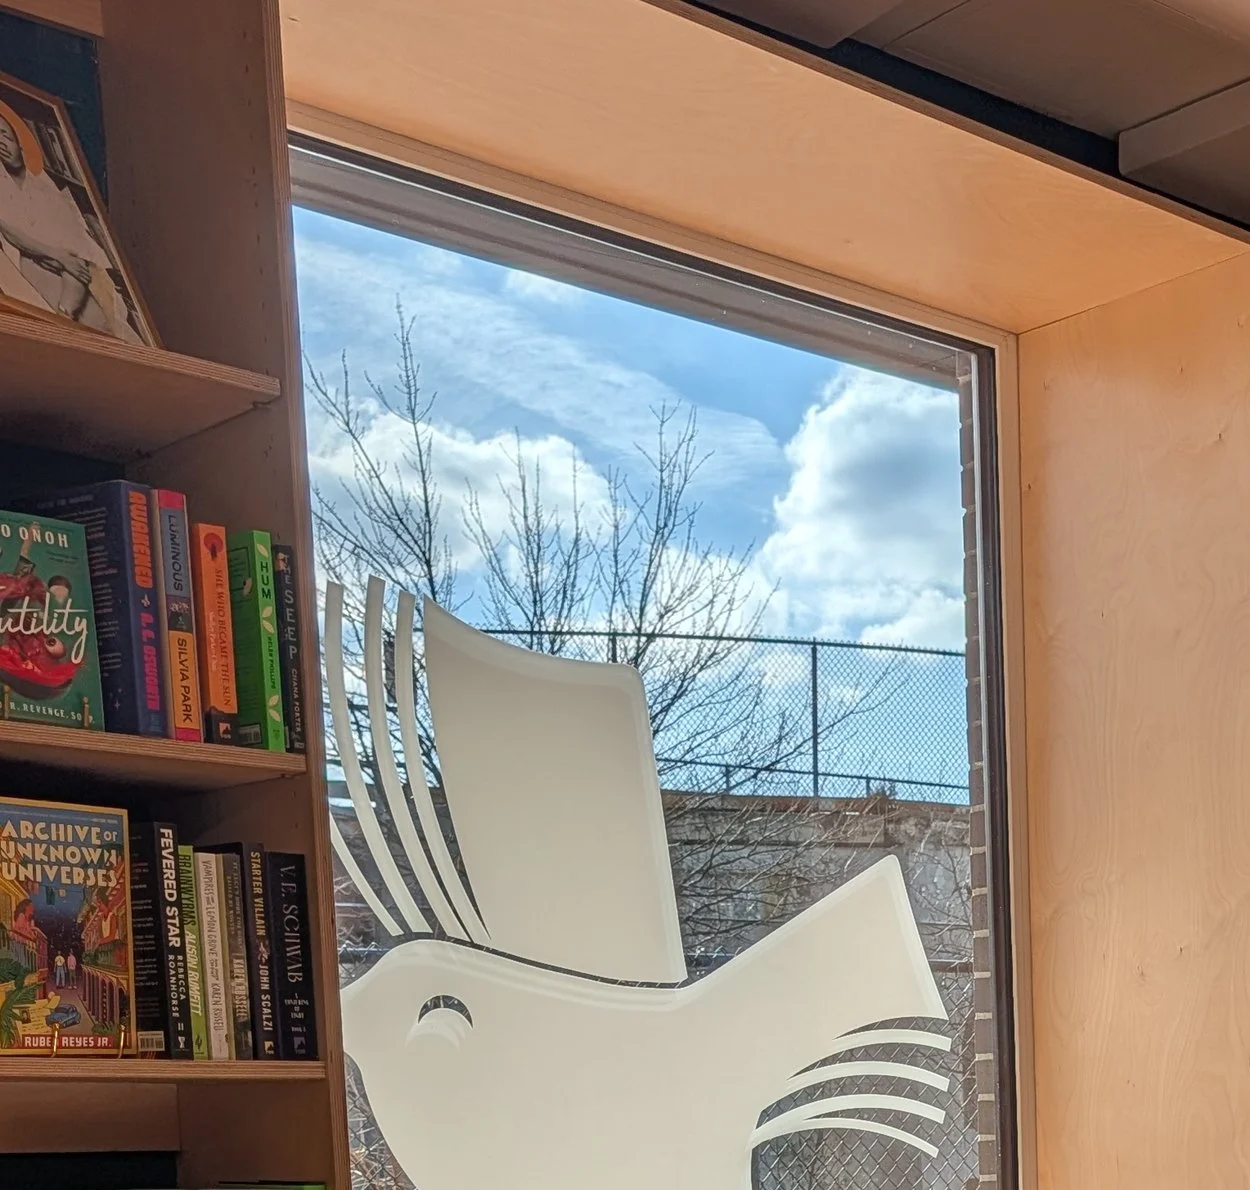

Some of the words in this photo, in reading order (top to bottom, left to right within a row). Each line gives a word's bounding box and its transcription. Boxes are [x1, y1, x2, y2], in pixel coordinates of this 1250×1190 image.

[19, 527, 69, 548] ONOH
[168, 515, 183, 591] LUMINOUS
[260, 561, 271, 599] HUM
[217, 620, 227, 658] BECAME
[284, 590, 297, 659] SEEP
[178, 638, 190, 680] SILVIA
[181, 683, 193, 723] PARK
[2, 820, 101, 845] ARCHIVE
[1, 841, 117, 866] UNKNOWN
[160, 828, 177, 902] FEVERED
[2, 861, 117, 887] UNIVERSES
[178, 855, 196, 926] BRAINWYRMS
[250, 851, 263, 897] STARTER
[166, 906, 180, 948] STAR
[253, 898, 266, 936] VILLAIN
[282, 905, 303, 983] SCHWAB
[168, 955, 179, 1018] ROANHORSE
[177, 955, 186, 999] REBECCA
[258, 964, 270, 990] JOHN
[260, 993, 273, 1031] SCALZI
[62, 1036, 94, 1048] REYES
[97, 1036, 112, 1048] JR.
